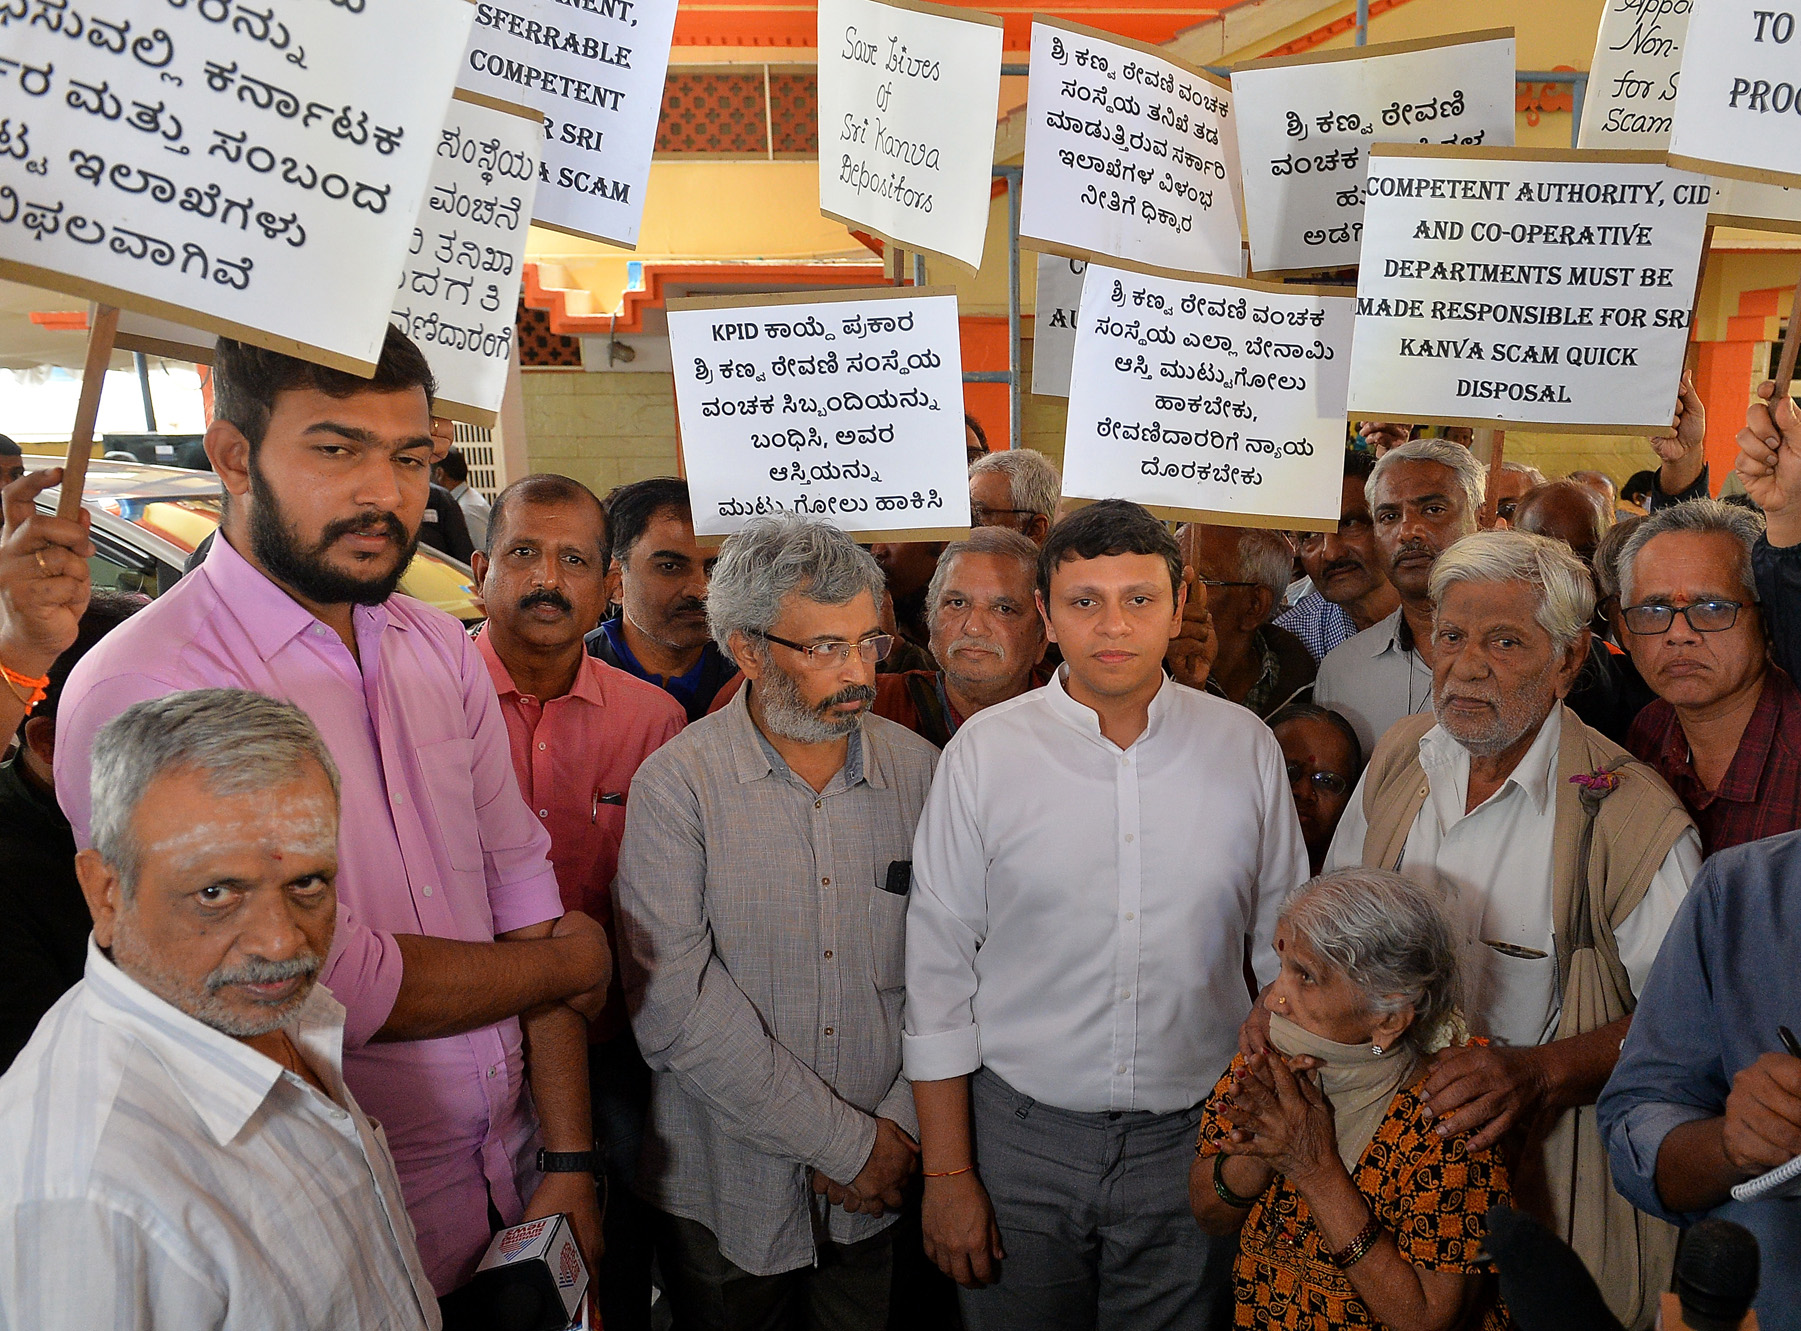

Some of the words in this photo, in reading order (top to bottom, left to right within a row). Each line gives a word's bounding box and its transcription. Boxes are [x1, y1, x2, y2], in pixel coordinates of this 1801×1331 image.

[475, 2, 633, 69] SFERRABLE
[1609, 23, 1678, 57] Non-
[1754, 10, 1795, 44] TO
[842, 26, 878, 66] Save
[469, 48, 626, 112] COMPETENT
[876, 81, 893, 113] of
[1074, 48, 1116, 80] ಕಣ್ವ
[1122, 62, 1174, 94] ಠೇವಣಿ
[1178, 83, 1229, 118] ವಂಚಕ
[1612, 70, 1654, 98] for
[204, 61, 403, 156] ಕರ್ನಾಟಕ
[1146, 104, 1189, 134] ತನಿಖೆ
[1193, 122, 1219, 146] ತಡ
[1316, 110, 1373, 135] ಕಣ್ವ
[1382, 90, 1465, 126] ಠೇವಣಿ
[65, 79, 190, 156] ಮತ್ತು
[207, 128, 392, 214] ಸಂಬಂದ
[560, 123, 604, 152] SRI
[841, 114, 868, 144] Sri
[875, 117, 941, 172] Kanva
[1046, 110, 1168, 158] ಮಾಡುತ್ತಿರುವ
[1172, 146, 1226, 180] ಸರ್ಕಾರಿ
[436, 126, 533, 186] ಸಂಸ್ಥೆಯ
[1271, 146, 1359, 176] ವಂಚಕ
[68, 148, 307, 248] ಇಲಾಖೆಗಳು
[556, 167, 631, 205] SCAM
[840, 154, 933, 213] Depositors
[1058, 148, 1154, 185] ಇಲಾಖೆಗಳ
[1158, 172, 1213, 212] ವಿಳಂಭ
[1367, 176, 1510, 200] COMPETENT
[1514, 180, 1664, 208] AUTHORITY,
[1674, 184, 1711, 205] CID
[430, 182, 522, 230] ವಂಚನೆ
[1080, 184, 1136, 216] ನೀತಿಗೆ
[1142, 200, 1192, 234] ಧಿಕ್ಕಾರ
[1412, 220, 1464, 241] AND
[1470, 222, 1652, 246] CO-OPERATIVE
[1384, 258, 1562, 286] DEPARTMENTS
[1567, 266, 1635, 286] MUST
[1640, 268, 1674, 288] BE
[712, 322, 758, 342] KPID
[764, 316, 836, 340] ಕಾಯ್ದೆ
[842, 310, 914, 338] ಪ್ರಕಾರ
[1132, 288, 1174, 316] ಕಣ್ವ
[1181, 294, 1246, 320] ಠೇವಣಿ
[1252, 306, 1325, 328] ವಂಚಕ
[1355, 298, 1424, 318] MADE
[1431, 301, 1593, 326] RESPONSIBLE
[1600, 308, 1648, 328] FOR
[1094, 316, 1176, 346] ಸಂಸ್ಥೆಯ
[1182, 332, 1238, 357] ಎಲ್ಲಾ
[1245, 338, 1334, 360] ಬೇನಾಮಿ
[1400, 338, 1485, 360] KANVA
[1490, 344, 1560, 364] SCAM
[1566, 347, 1638, 367] QUICK
[719, 358, 766, 382] ಕಣ್ವ
[772, 351, 839, 377] ಠೇವಣಿ
[846, 348, 940, 375] ಸಂಸ್ಥೆಯ
[1114, 354, 1152, 380] ಆಸ್ತಿ
[1160, 360, 1306, 390] ಮುಟ್ಟುಗೋಲು
[702, 394, 775, 417] ವಂಚಕ
[782, 387, 941, 418] ಸಿಬ್ಬಂದಿಯನ್ನು
[1154, 394, 1258, 422] ಹಾಕಬೇಕು,
[1456, 380, 1572, 404] DISPOSAL
[751, 428, 828, 451] ಬಂಧಿಸಿ,
[836, 424, 895, 446] ಅವರ
[1096, 416, 1239, 452] ಠೇವಣಿದಾರರಿಗೆ
[1246, 438, 1314, 458] ನ್ಯಾಯ
[770, 459, 882, 486] ಆಸ್ತಿಯನ್ನು
[1140, 456, 1262, 486] ದೊರಕಬೇಕು
[875, 488, 942, 510] ಹಾಕಿಸಿ
